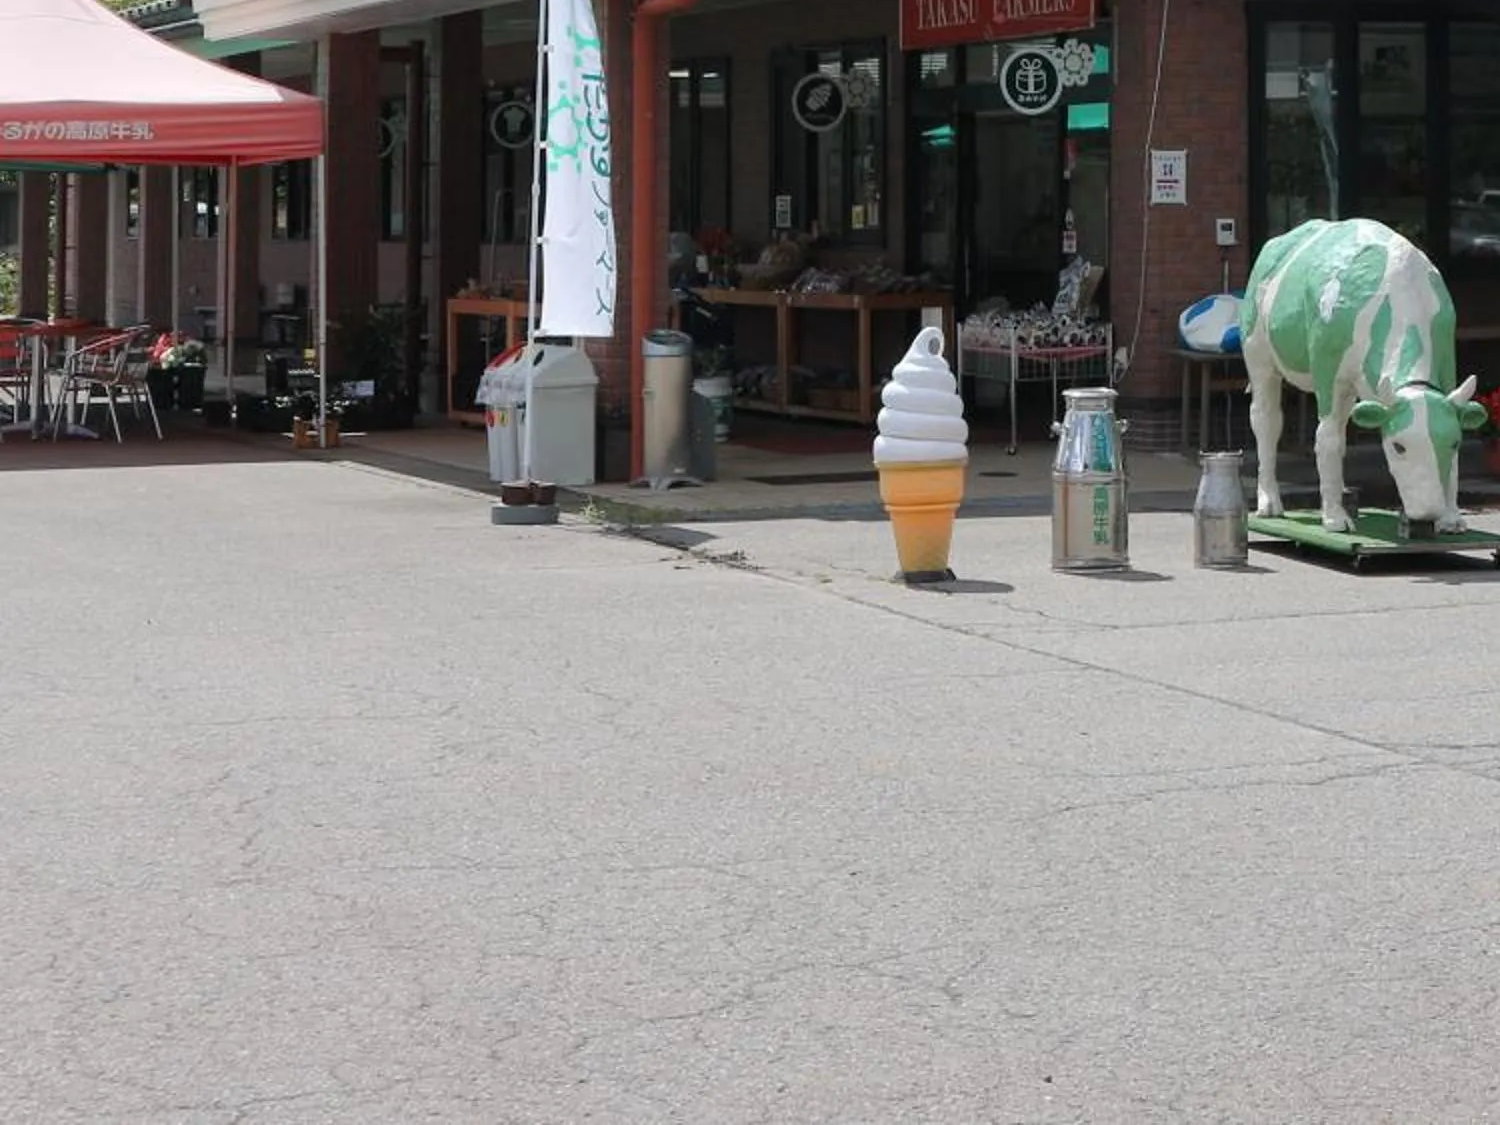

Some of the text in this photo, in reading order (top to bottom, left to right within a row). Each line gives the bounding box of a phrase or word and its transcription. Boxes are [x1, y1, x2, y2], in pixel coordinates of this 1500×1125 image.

[0, 122, 153, 140] るがの高原牛乳
